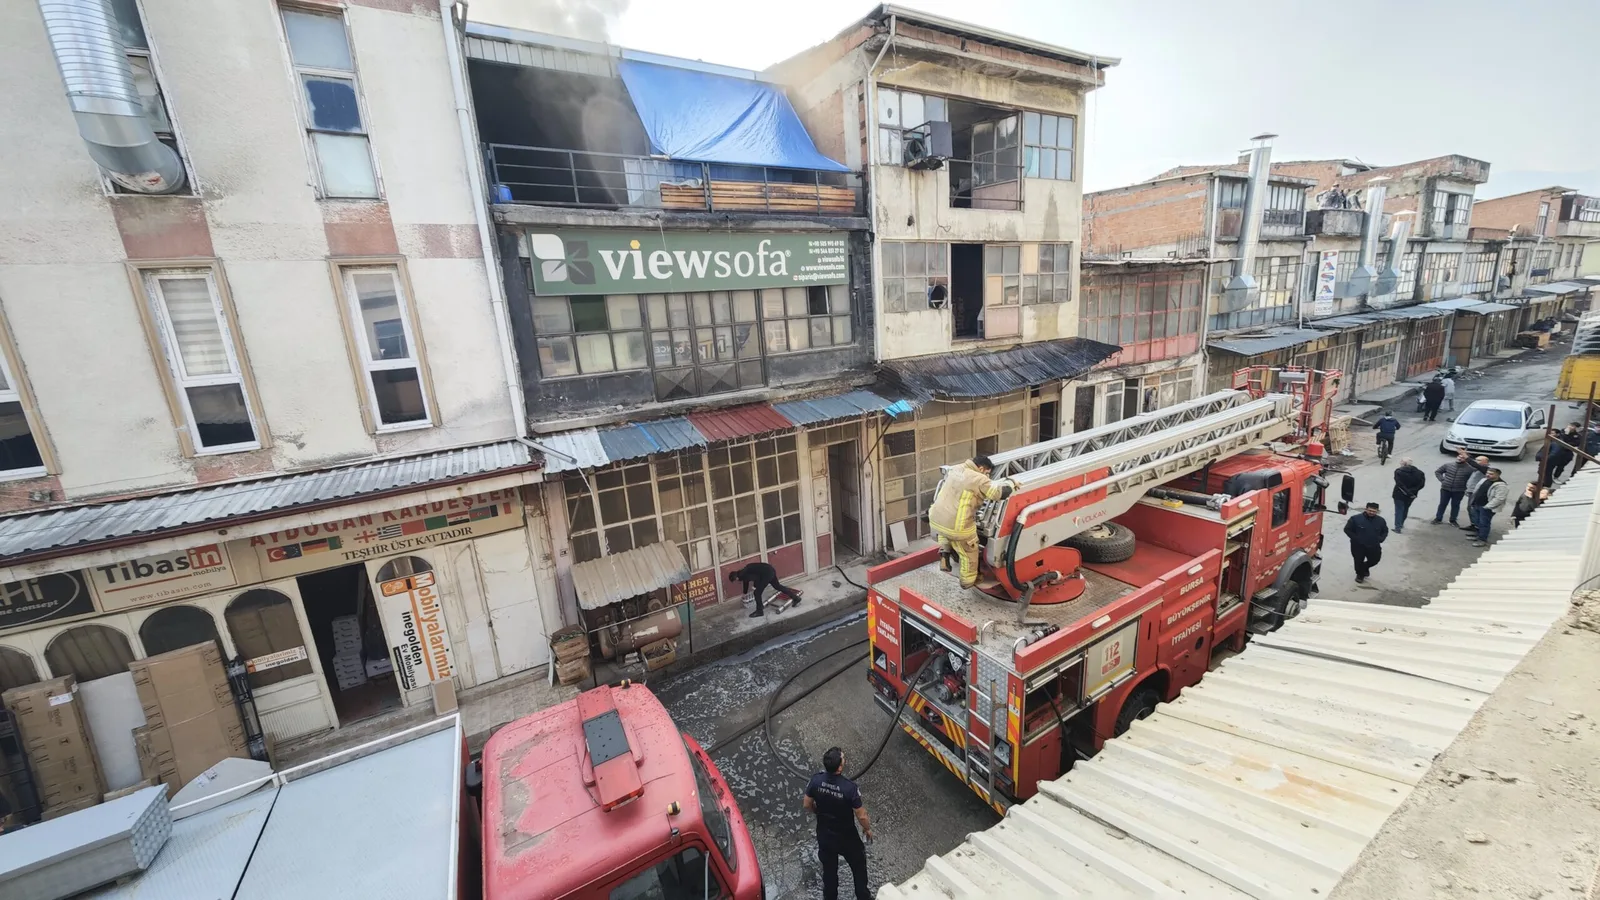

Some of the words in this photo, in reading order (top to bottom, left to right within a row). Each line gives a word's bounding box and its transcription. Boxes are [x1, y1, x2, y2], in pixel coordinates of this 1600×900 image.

[342, 543, 390, 561] TEŞHİR
[390, 537, 414, 550] ÜST
[416, 526, 473, 546] KATTADIR
[96, 549, 220, 584] Tibasin
[193, 565, 226, 577] mobilya
[129, 581, 212, 602] www.tibasin.com
[1180, 576, 1204, 596] BURSA
[16, 599, 59, 613] consept
[1167, 594, 1211, 625] BÜYÜKŞEHİR
[402, 611, 423, 666] inegolden
[1171, 620, 1202, 646] İTFAİYESİ
[401, 643, 410, 654] Ev
[1104, 640, 1120, 662] 112
